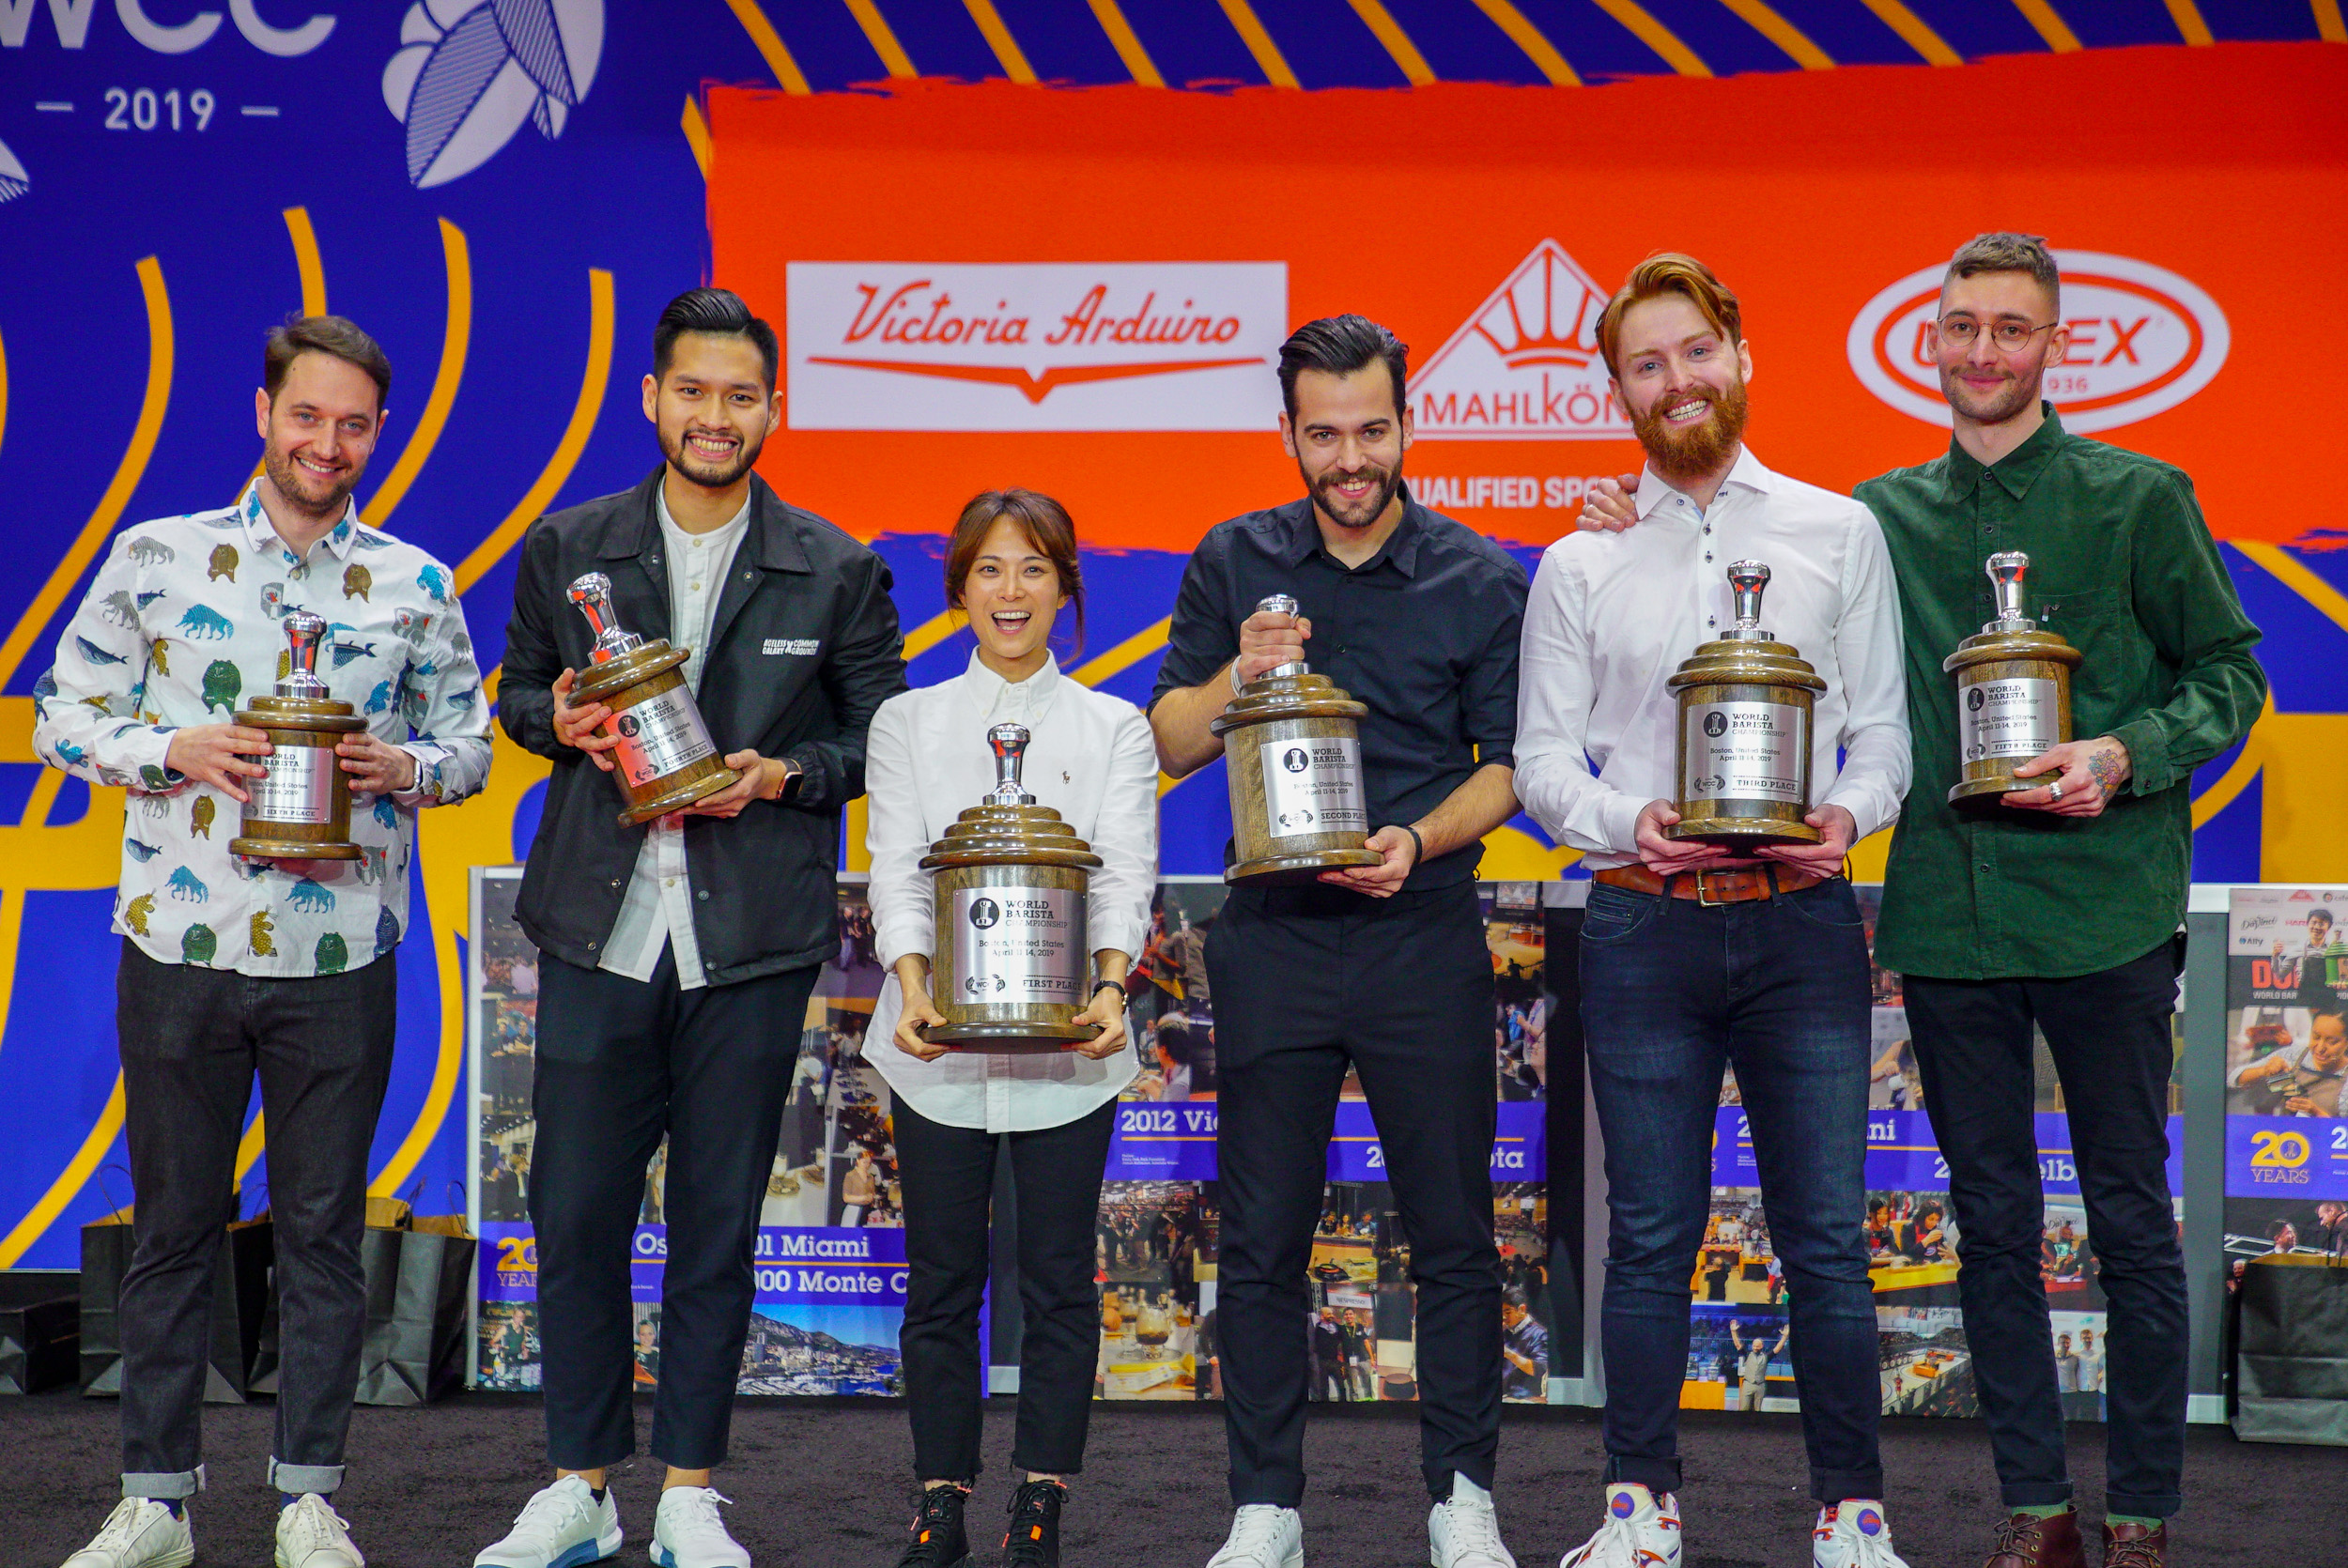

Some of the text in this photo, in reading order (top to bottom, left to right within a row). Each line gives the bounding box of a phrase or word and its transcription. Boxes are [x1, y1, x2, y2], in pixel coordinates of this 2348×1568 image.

[103, 87, 217, 131] 2019
[842, 279, 1241, 346] Victoria Arduino
[2043, 377, 2089, 392] 936
[1402, 475, 1539, 508] UALIFIED
[1987, 685, 2021, 694] WORLD
[1987, 692, 2026, 700] BARISTA
[640, 700, 670, 716] WORLD
[642, 705, 676, 723] BARISTA
[1732, 721, 1773, 730] BARISTA
[664, 753, 692, 767] FOURTH
[1737, 779, 1797, 791] THIRD PLACE
[1005, 899, 1049, 909] WORLD
[1005, 910, 1055, 919] BARISTA
[1042, 940, 1065, 948] States
[1023, 979, 1053, 988] FIRST
[2253, 991, 2280, 999] WORLD
[1120, 1110, 1176, 1132] 2012
[2250, 1130, 2310, 1169] 20
[2250, 1168, 2309, 1184] YEARS
[780, 1235, 870, 1257] Miami
[797, 1270, 884, 1294] Monte
